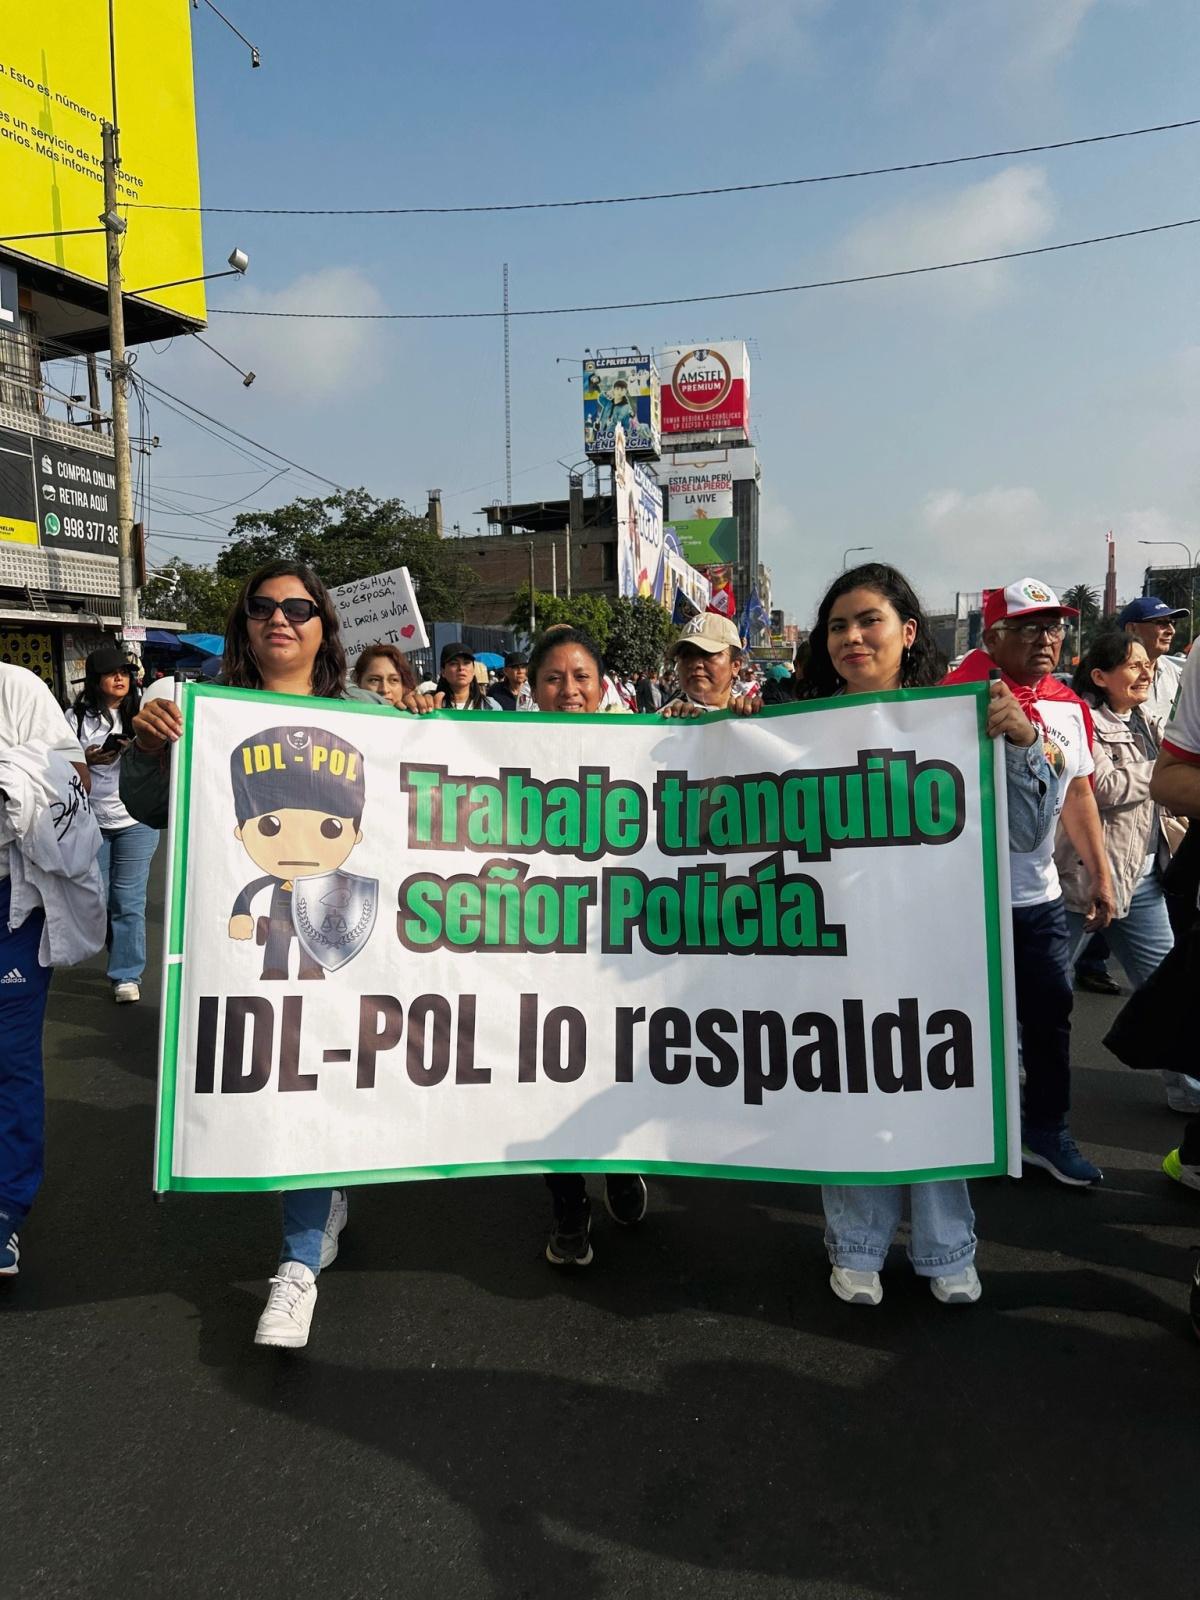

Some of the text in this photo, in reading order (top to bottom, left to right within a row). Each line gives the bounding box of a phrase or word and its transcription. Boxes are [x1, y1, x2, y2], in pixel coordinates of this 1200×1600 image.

[10, 67, 34, 88] Esto
[37, 84, 53, 100] es,
[55, 92, 96, 121] número
[13, 118, 28, 132] un
[31, 126, 74, 154] servicio
[76, 147, 90, 161] de
[36, 142, 60, 162] Más
[62, 154, 124, 193] informan
[126, 188, 138, 200] en
[680, 370, 722, 384] AMSTEL
[682, 382, 721, 392] PREMIUM
[588, 439, 649, 450] TENDCIA
[596, 430, 628, 440] MOA
[57, 461, 116, 490] COMPRA ONLIN
[669, 476, 688, 485] ESTA
[689, 474, 710, 484] FINAL
[671, 484, 682, 492] NO
[682, 484, 691, 492] SE
[692, 483, 703, 491] LA
[59, 486, 108, 512] RETIRA AQUÍ
[685, 493, 717, 504] LA VIVE
[64, 516, 119, 545] 998 377 36
[336, 584, 359, 597] SOY
[389, 601, 409, 616] VIDA
[1042, 725, 1071, 747] UNTOS
[242, 743, 287, 776] IDL
[312, 746, 358, 782] POL
[402, 754, 961, 858] Trabaje tranquilo
[400, 856, 843, 953] señor Policía.
[194, 993, 976, 1106] IDL-POL lo respalda
